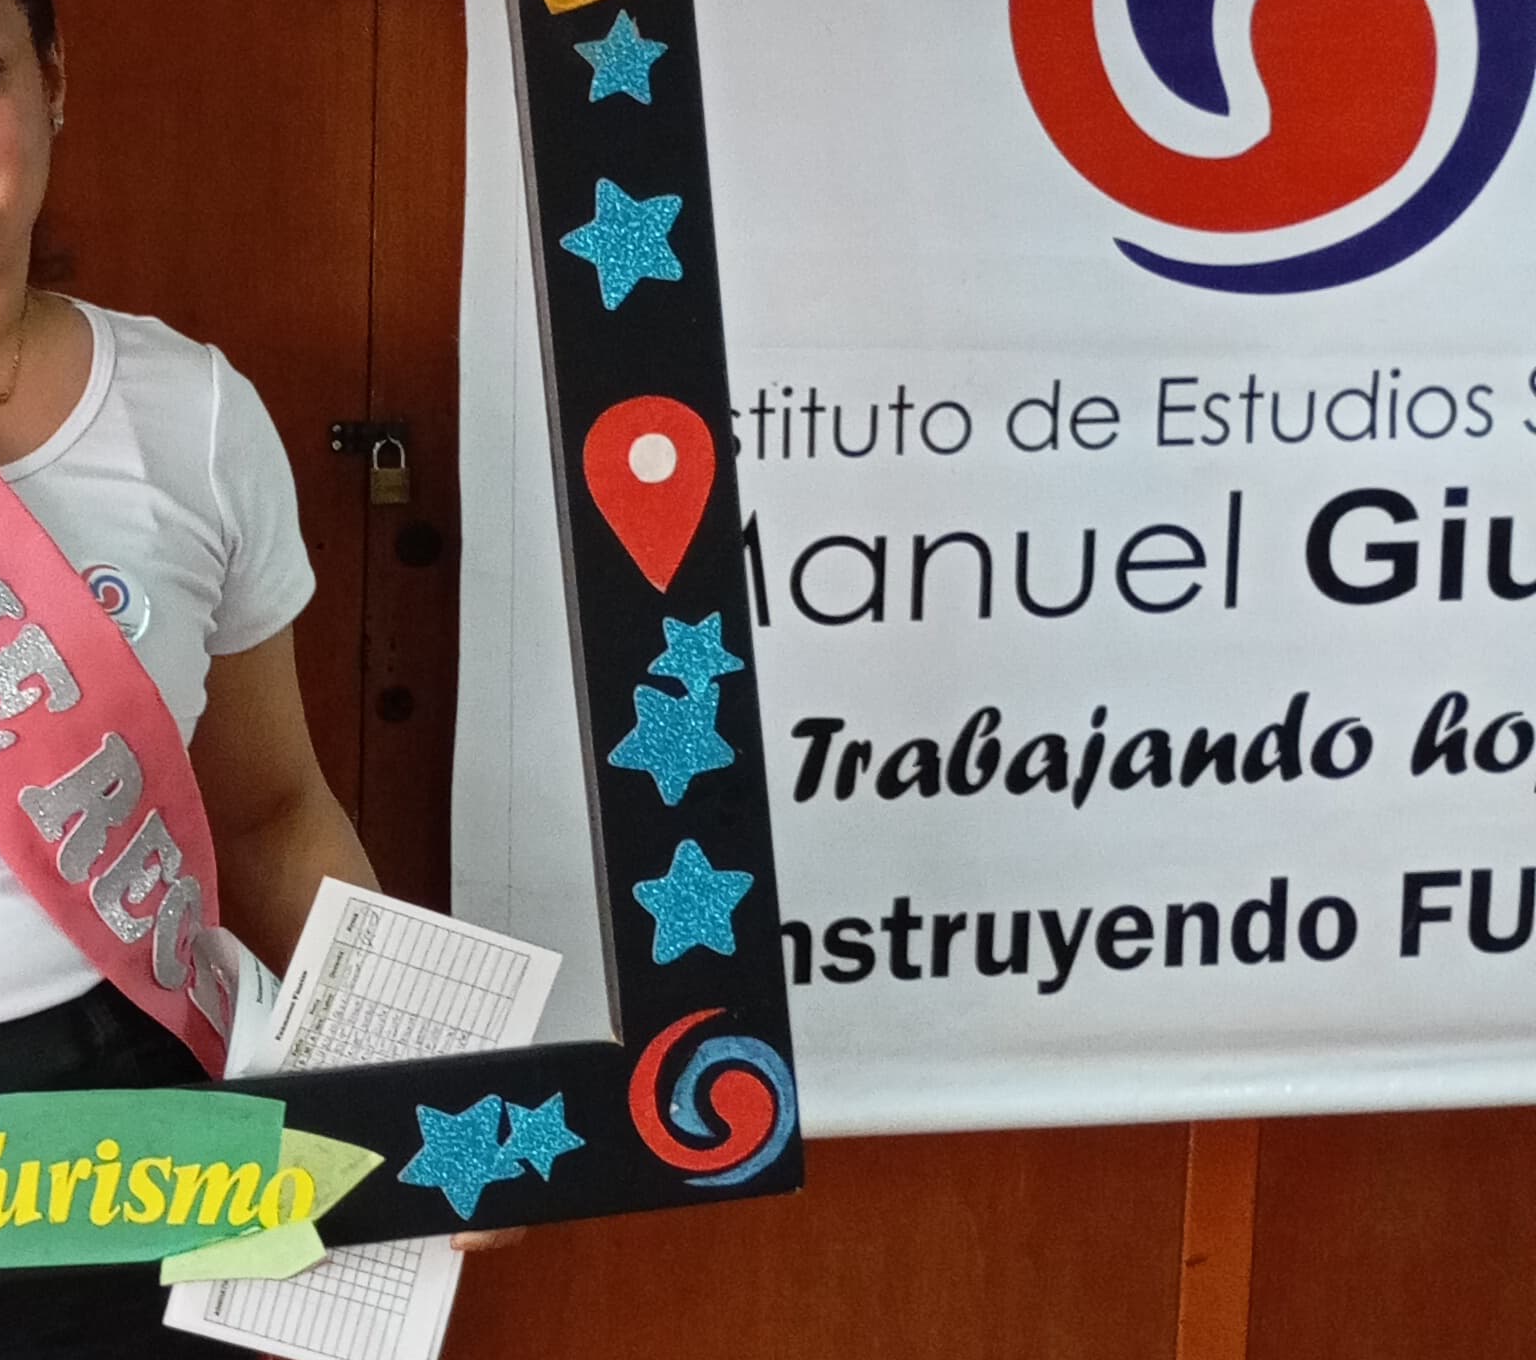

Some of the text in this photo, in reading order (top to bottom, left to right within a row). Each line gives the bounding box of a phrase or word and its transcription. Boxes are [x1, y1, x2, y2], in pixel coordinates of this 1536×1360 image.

[1005, 378, 1121, 452] de
[1156, 368, 1495, 448] Estudios
[790, 690, 1536, 810] Trabajando ho
[1400, 866, 1536, 958] FU
